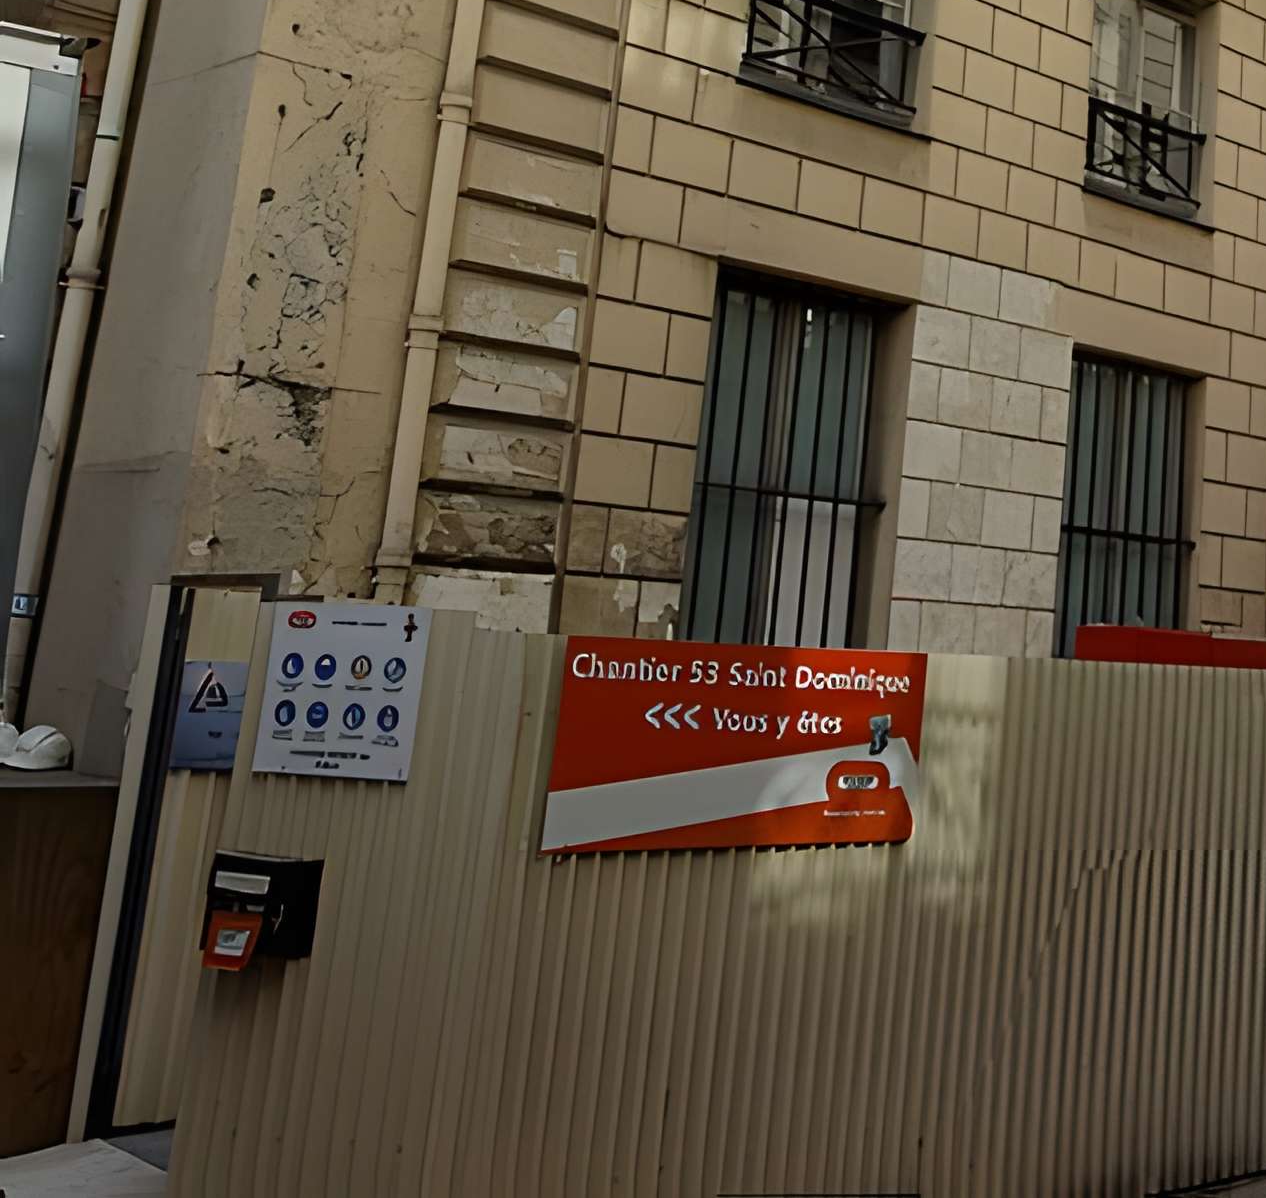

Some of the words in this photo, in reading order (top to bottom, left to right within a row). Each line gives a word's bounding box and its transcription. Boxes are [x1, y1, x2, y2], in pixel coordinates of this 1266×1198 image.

[572, 652, 682, 682] Chantier
[689, 660, 719, 685] 53
[728, 661, 787, 688] Saint
[795, 665, 910, 698] Dominique
[713, 707, 768, 733] Vous
[775, 714, 790, 740] y
